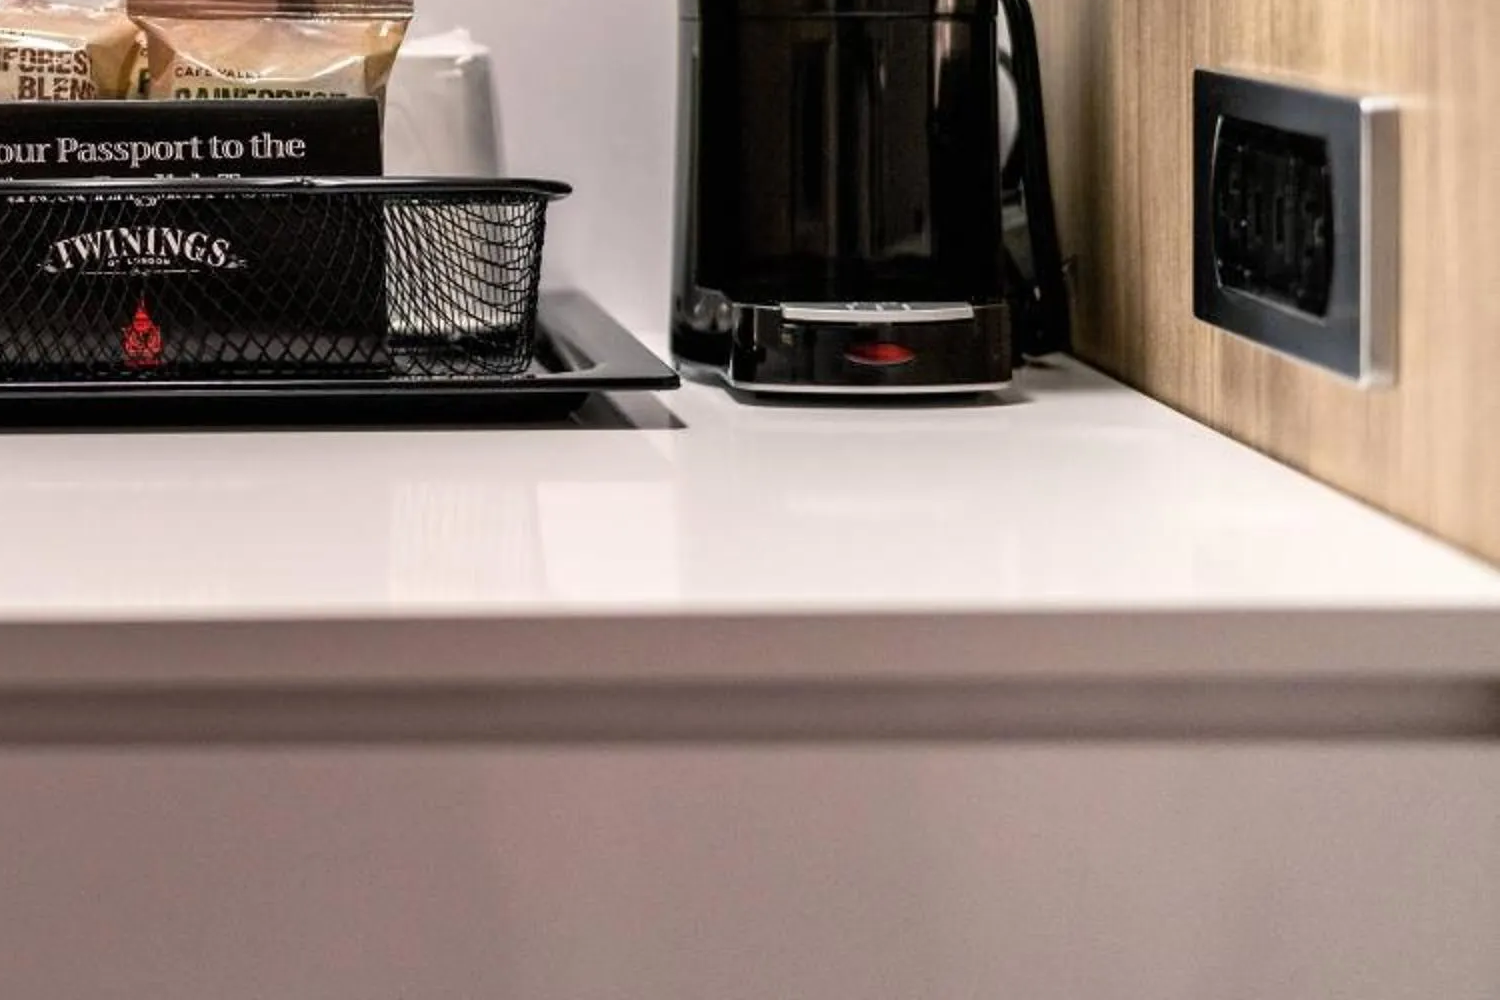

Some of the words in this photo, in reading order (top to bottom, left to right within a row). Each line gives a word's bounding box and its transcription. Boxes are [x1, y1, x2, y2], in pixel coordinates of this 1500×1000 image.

[56, 136, 202, 168] Passport
[209, 136, 244, 160] to
[250, 132, 306, 159] the
[54, 226, 230, 269] TWININGS
